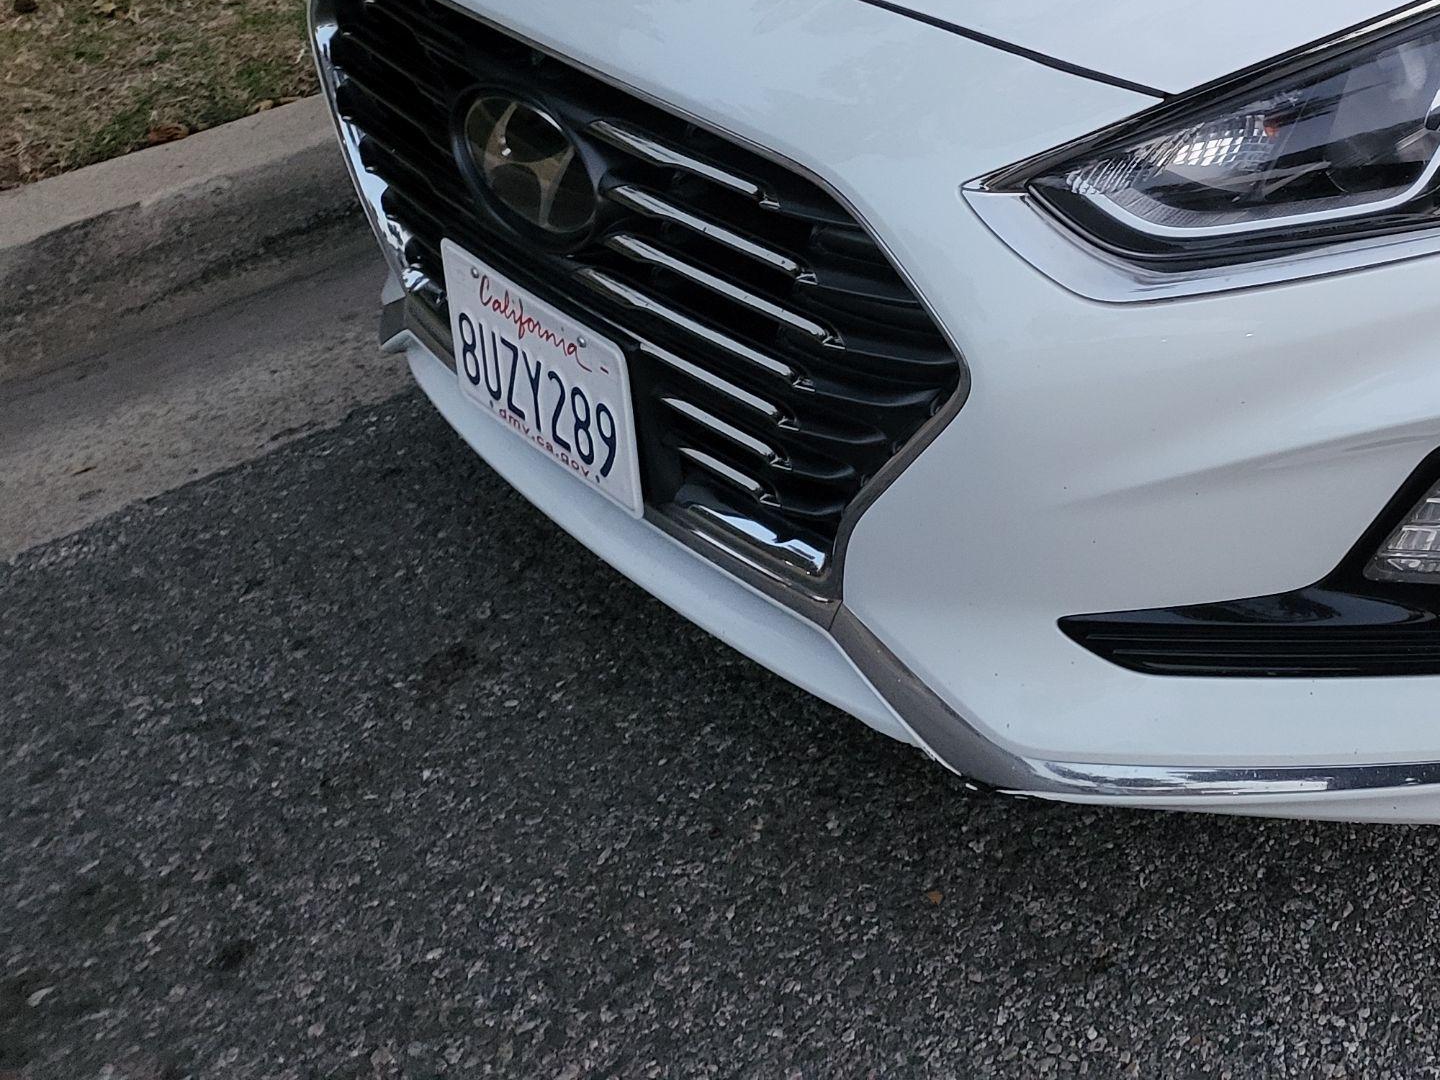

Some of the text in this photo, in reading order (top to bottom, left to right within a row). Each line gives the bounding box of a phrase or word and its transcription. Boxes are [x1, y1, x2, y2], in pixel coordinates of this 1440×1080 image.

[479, 275, 592, 372] California
[458, 312, 617, 477] 8UZY289
[498, 407, 590, 477] dmv.ca.gov
